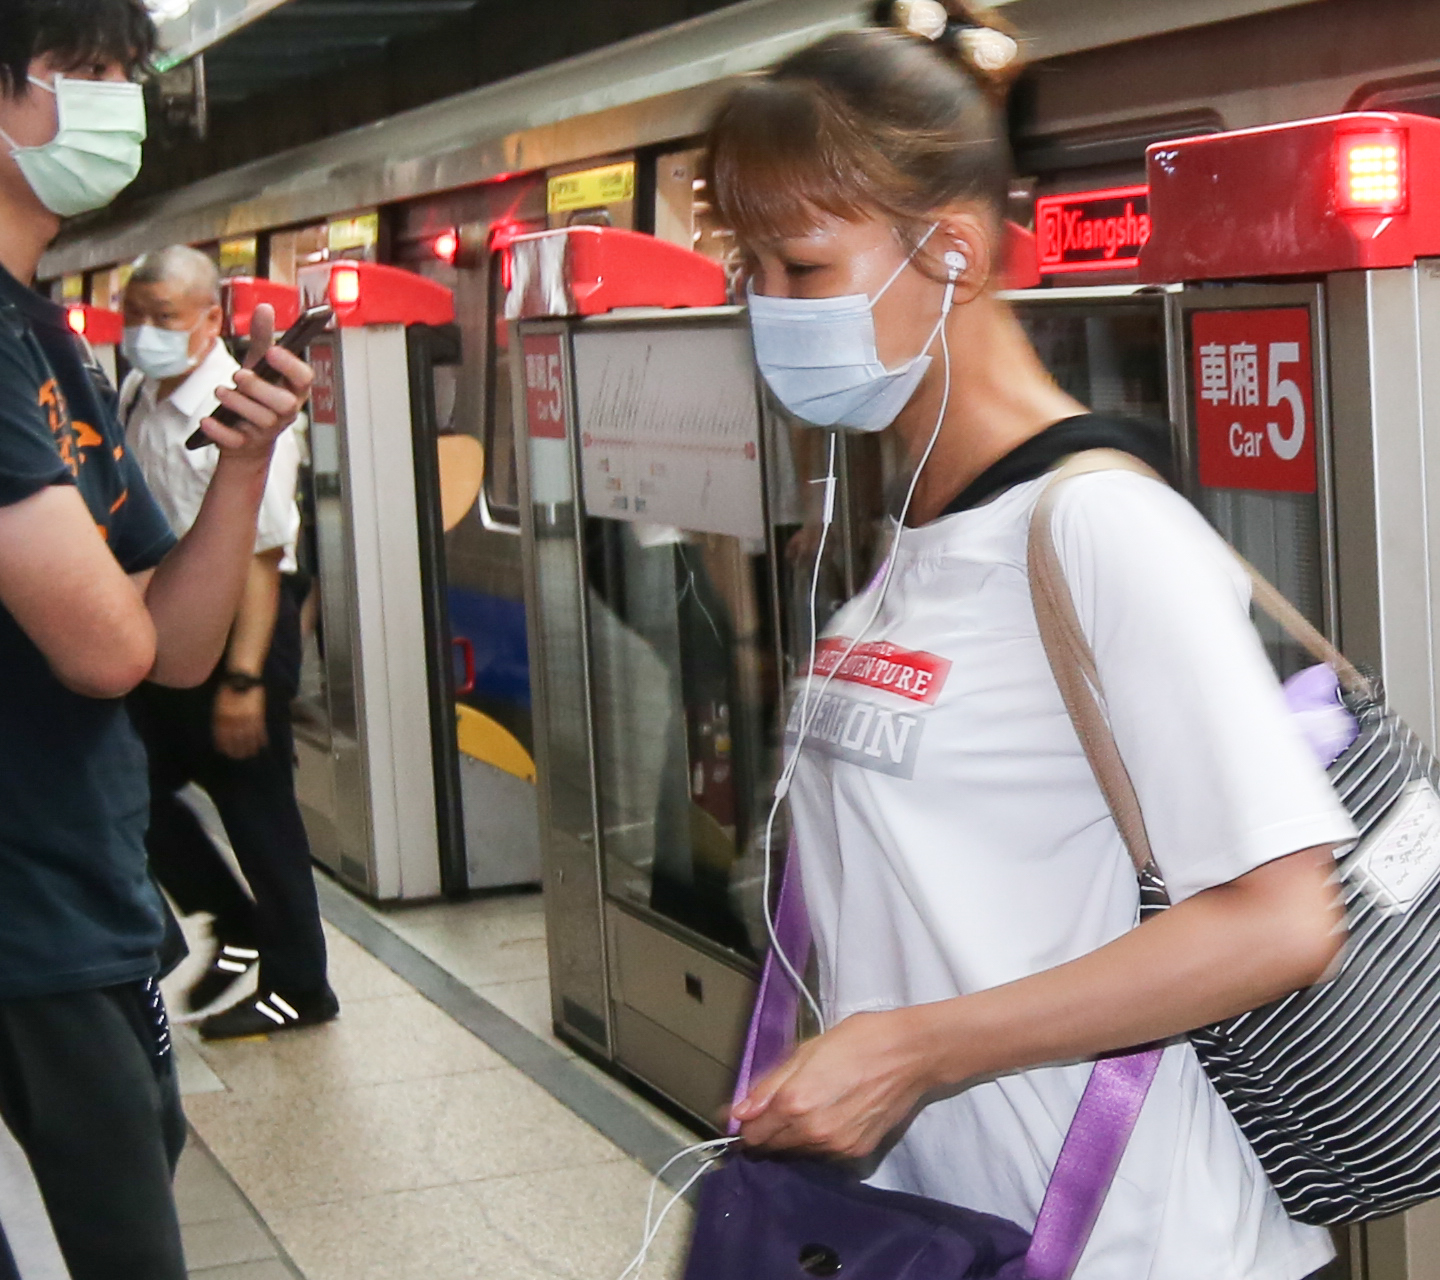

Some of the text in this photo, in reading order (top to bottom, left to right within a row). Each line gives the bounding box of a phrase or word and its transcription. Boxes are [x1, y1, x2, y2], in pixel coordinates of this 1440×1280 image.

[1063, 201, 1151, 259] Xiangsha
[1199, 341, 1306, 461] 車廂 5
[1229, 422, 1264, 457] Car
